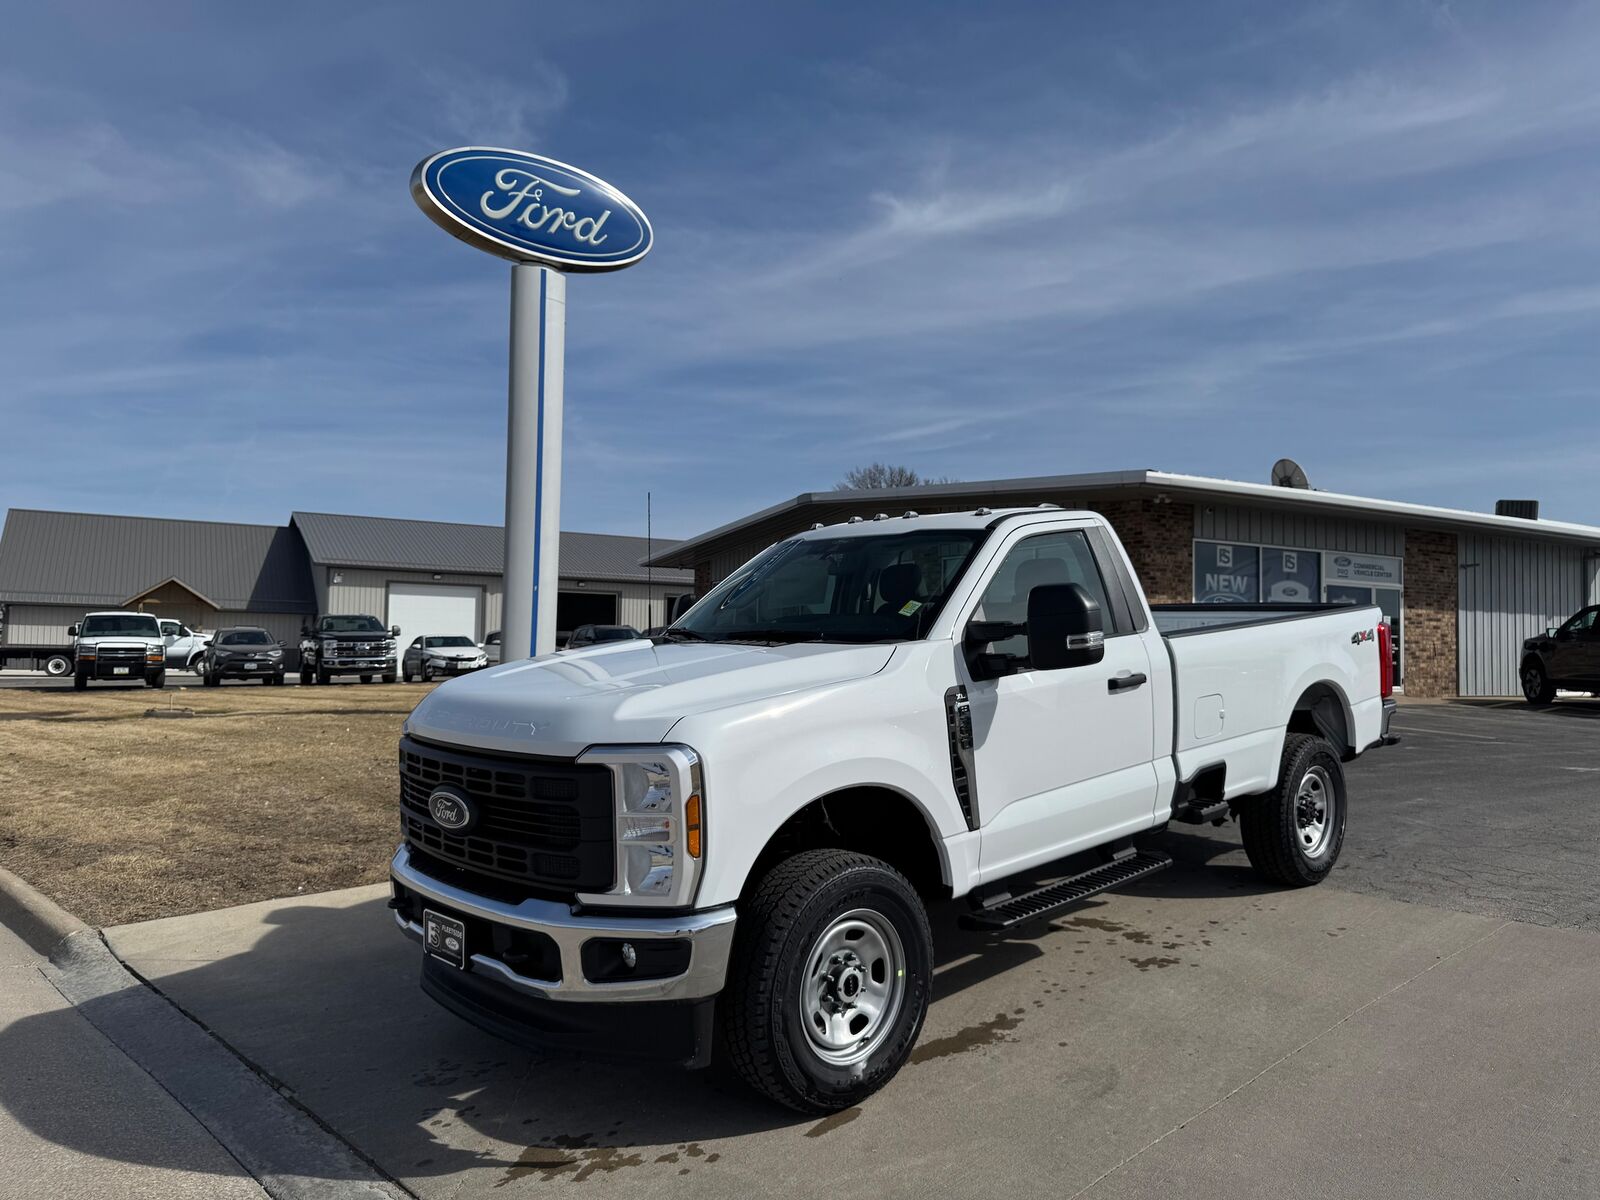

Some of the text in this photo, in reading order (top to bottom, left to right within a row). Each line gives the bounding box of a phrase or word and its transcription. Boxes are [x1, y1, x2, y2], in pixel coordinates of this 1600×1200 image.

[480, 168, 611, 246] Ford
[1353, 563, 1385, 571] COMMERCIAL
[1205, 573, 1248, 594] NEW
[435, 798, 458, 822] Ford
